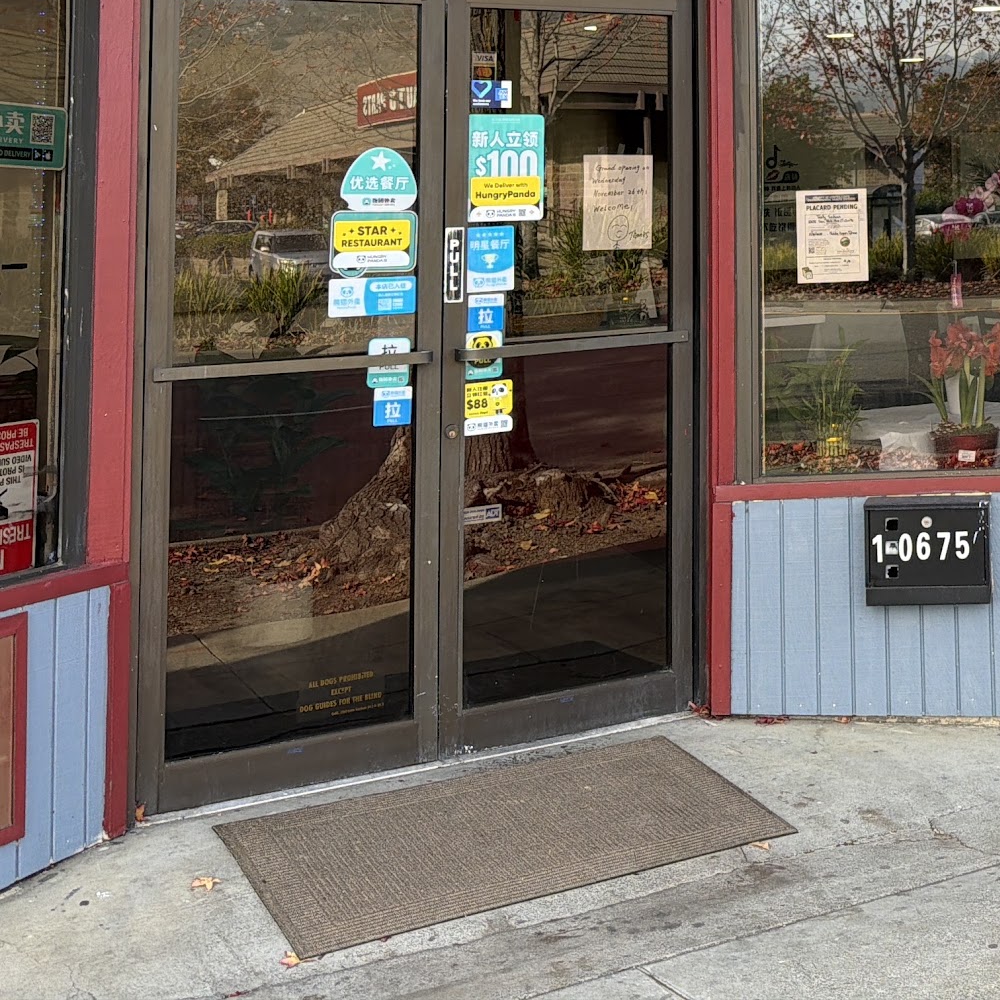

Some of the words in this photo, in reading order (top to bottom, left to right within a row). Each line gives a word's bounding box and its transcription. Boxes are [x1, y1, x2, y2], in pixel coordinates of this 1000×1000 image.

[476, 54, 494, 62] VISA
[0, 111, 25, 135] 卖
[471, 131, 539, 148] 新人立领
[475, 149, 538, 177] $100
[595, 163, 616, 172] Grand
[350, 176, 409, 190] 优选餐厅
[475, 190, 536, 200] HungryPanda
[357, 226, 388, 236] STAR
[341, 238, 403, 248] RESTAURANT
[470, 239, 510, 251] 明星餐厅
[450, 239, 460, 291] PULL
[478, 308, 494, 325] 拉
[384, 402, 401, 418] 拉
[467, 398, 488, 410] $88
[0, 428, 17, 440] PRO
[18, 428, 28, 437] BE
[12, 454, 31, 464] VIDEO
[18, 465, 25, 474] IS
[6, 474, 21, 486] THIS
[486, 508, 500, 518] ADT
[872, 530, 970, 563] 10675
[308, 681, 319, 689] ALL
[320, 677, 337, 687] DOGS
[338, 671, 374, 683] PROHIBITED
[331, 686, 352, 696] EXCEPT
[300, 704, 313, 713] DOG
[315, 701, 337, 710] GUIDES
[338, 697, 351, 706] FOR
[352, 694, 363, 702] THE
[364, 691, 383, 701] BLIND
